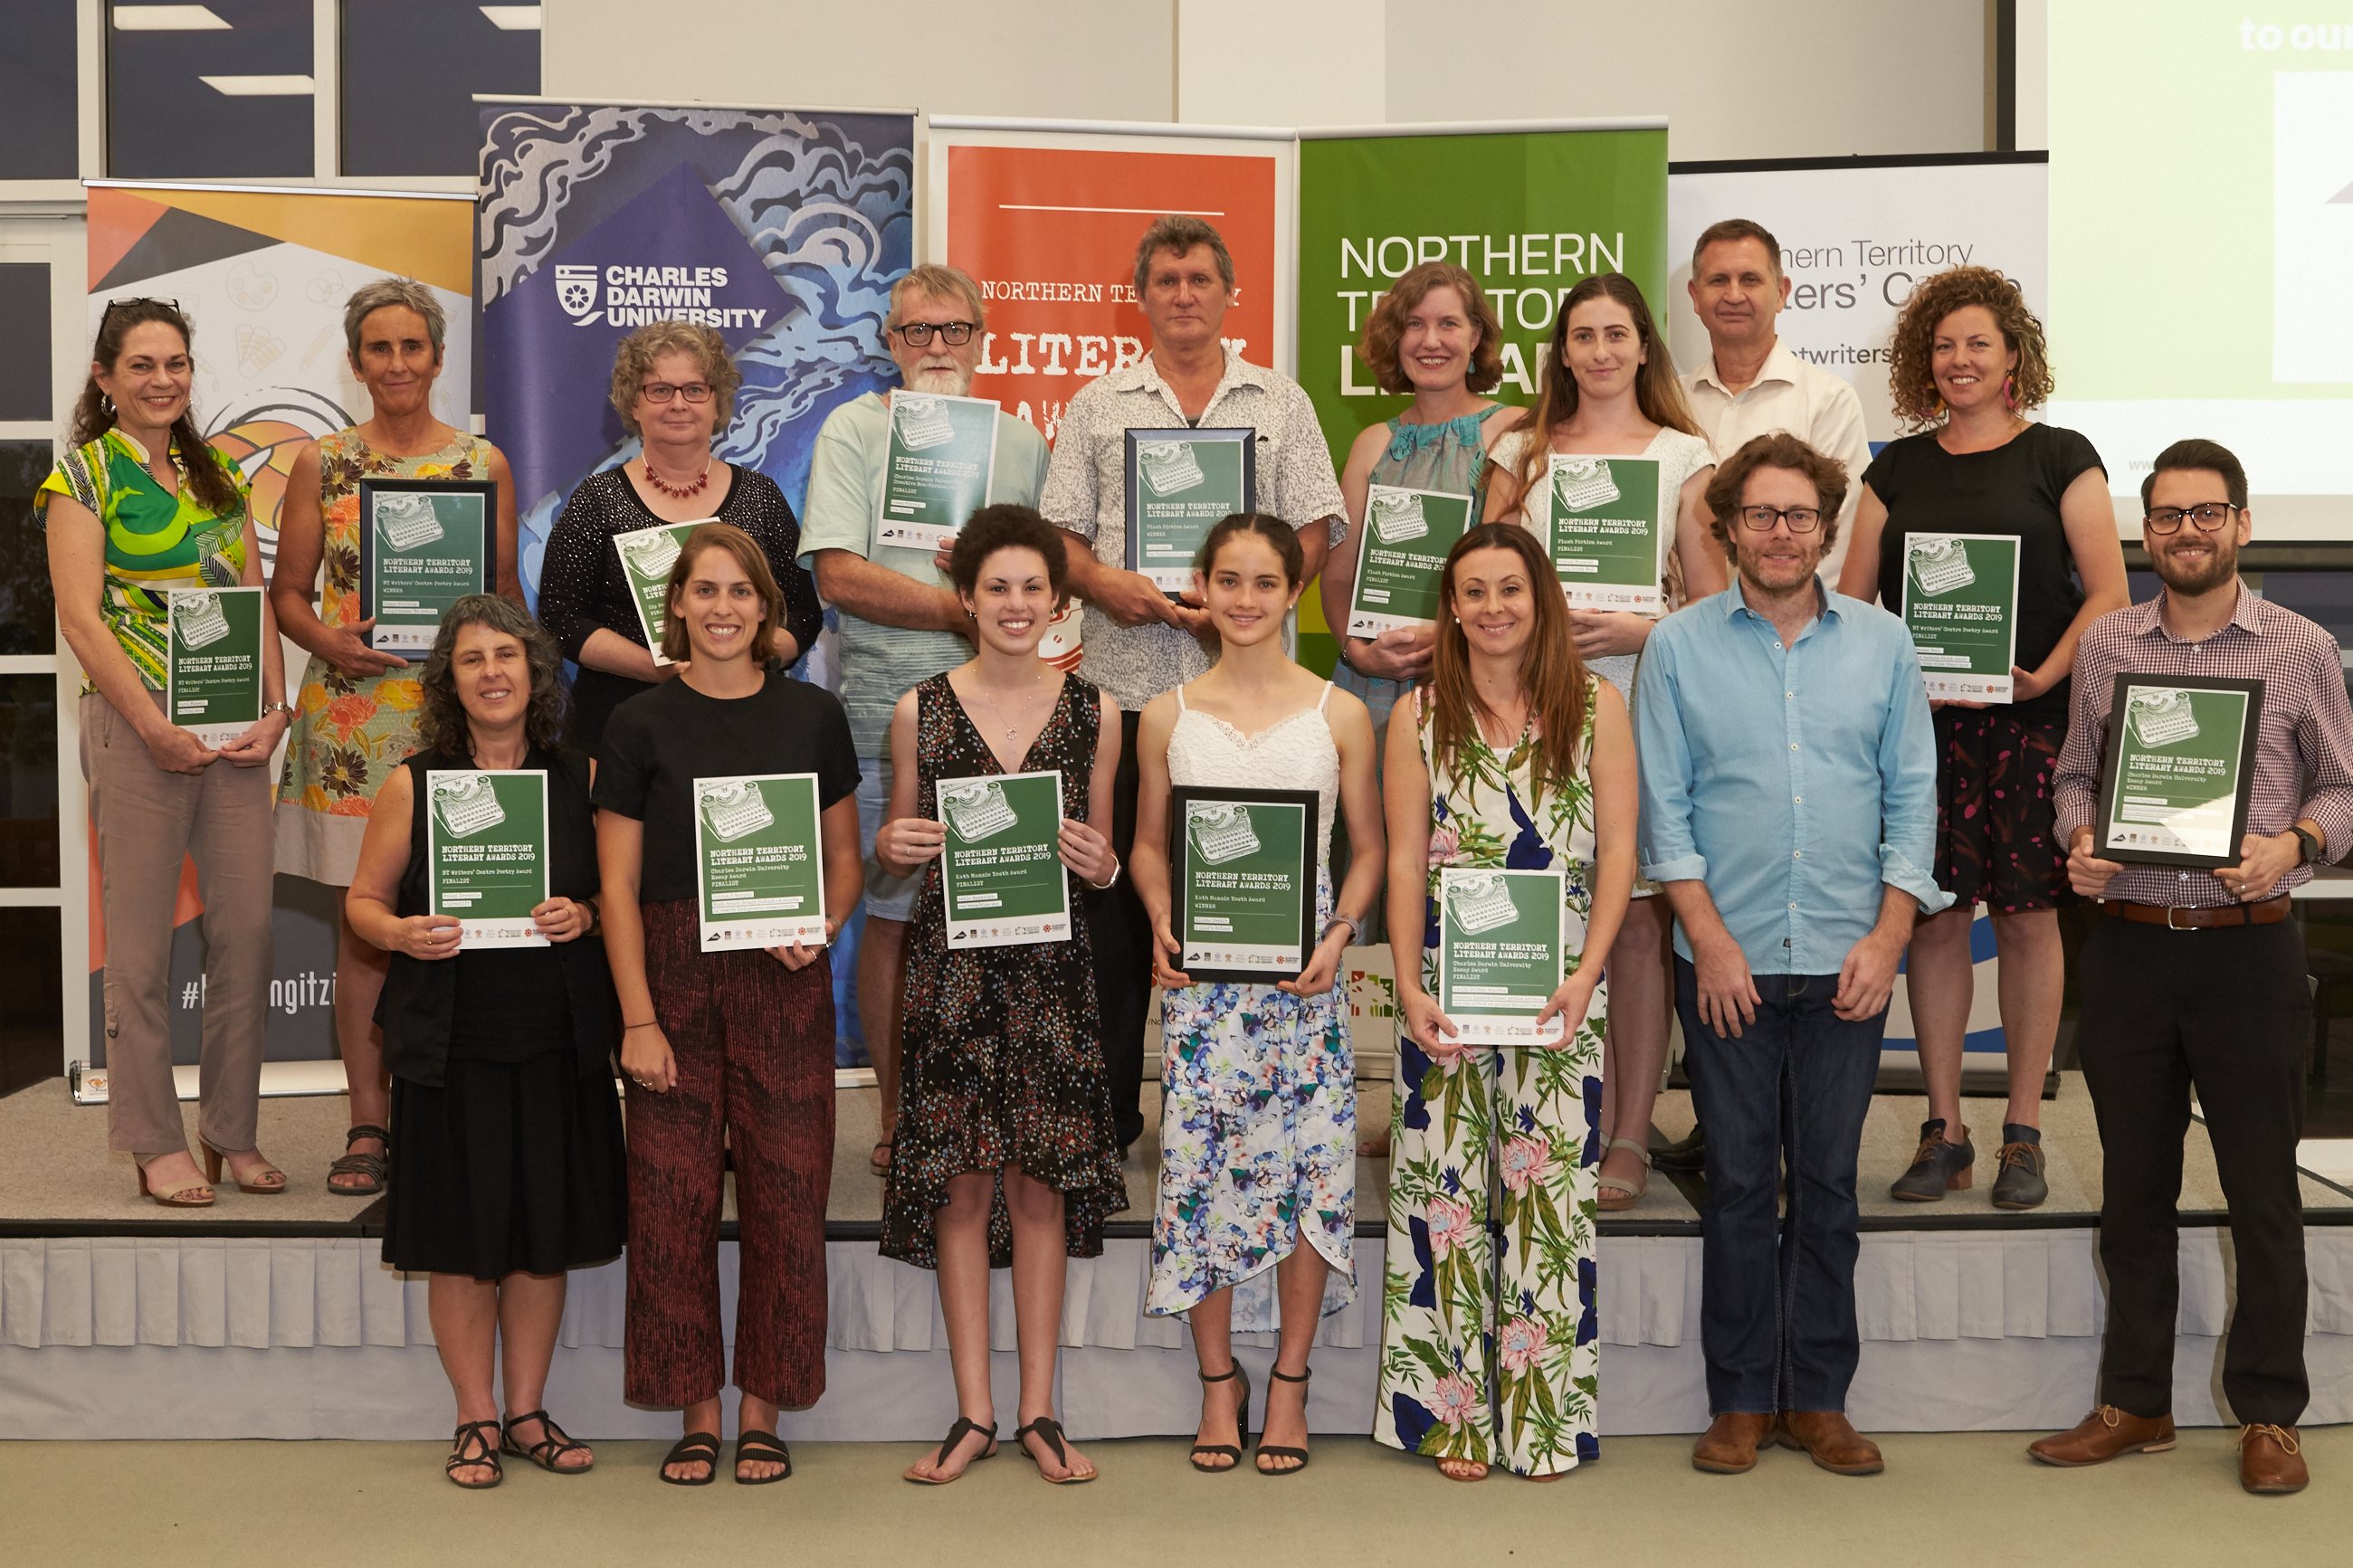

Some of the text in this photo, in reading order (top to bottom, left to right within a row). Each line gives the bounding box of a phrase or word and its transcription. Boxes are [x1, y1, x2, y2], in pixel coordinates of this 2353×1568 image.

[2239, 17, 2283, 51] to
[1341, 233, 1624, 278] NORTHERN
[1852, 239, 1973, 265] Territory
[605, 265, 728, 287] CHARLES
[607, 287, 711, 307] DARWIN
[981, 281, 1103, 303] NORTHERN
[607, 308, 767, 328] UNIVERSITY
[975, 332, 1144, 375] LITER
[896, 456, 977, 470] NORTHERN TERRITORY
[896, 463, 932, 473] LITERARY
[934, 468, 959, 476] AWARDS
[1602, 519, 1646, 527] TERRITORY
[1631, 527, 1648, 536] 2019
[1370, 548, 1406, 559] NORTHERN
[1369, 556, 1405, 566] LITERARY
[1405, 561, 1432, 569] AWARDS
[643, 583, 668, 594] NORTH
[645, 590, 666, 599] LITE
[1914, 603, 2001, 613] NORTHERN TERRITORY
[1914, 611, 1952, 619] LITERARY
[1986, 613, 2003, 622] 2019
[178, 655, 251, 665] NORTHERN TERRITORY
[179, 664, 212, 672] LITERARY
[2129, 754, 2224, 767] NORTHERN TERRITORY
[2129, 762, 2225, 775] LITERARY AWARDS 2019
[442, 845, 484, 853] NORTHERN
[710, 845, 804, 858] NORTHERN TERRITORY
[954, 844, 1048, 859] NORTHERN TERRITORY
[443, 854, 483, 862] LITERARY
[711, 853, 806, 866] LITERARY AWARDS 2019
[955, 851, 1051, 867] LITERARY AWARDS 2019
[1196, 871, 1289, 882] NORTHERN TERRITORY
[1196, 880, 1291, 890] LITERARY AWARDS 2019
[1453, 942, 1547, 952] NORTHERN TERRITORY
[1453, 950, 1549, 961] LITERARY AWARDS 2019
